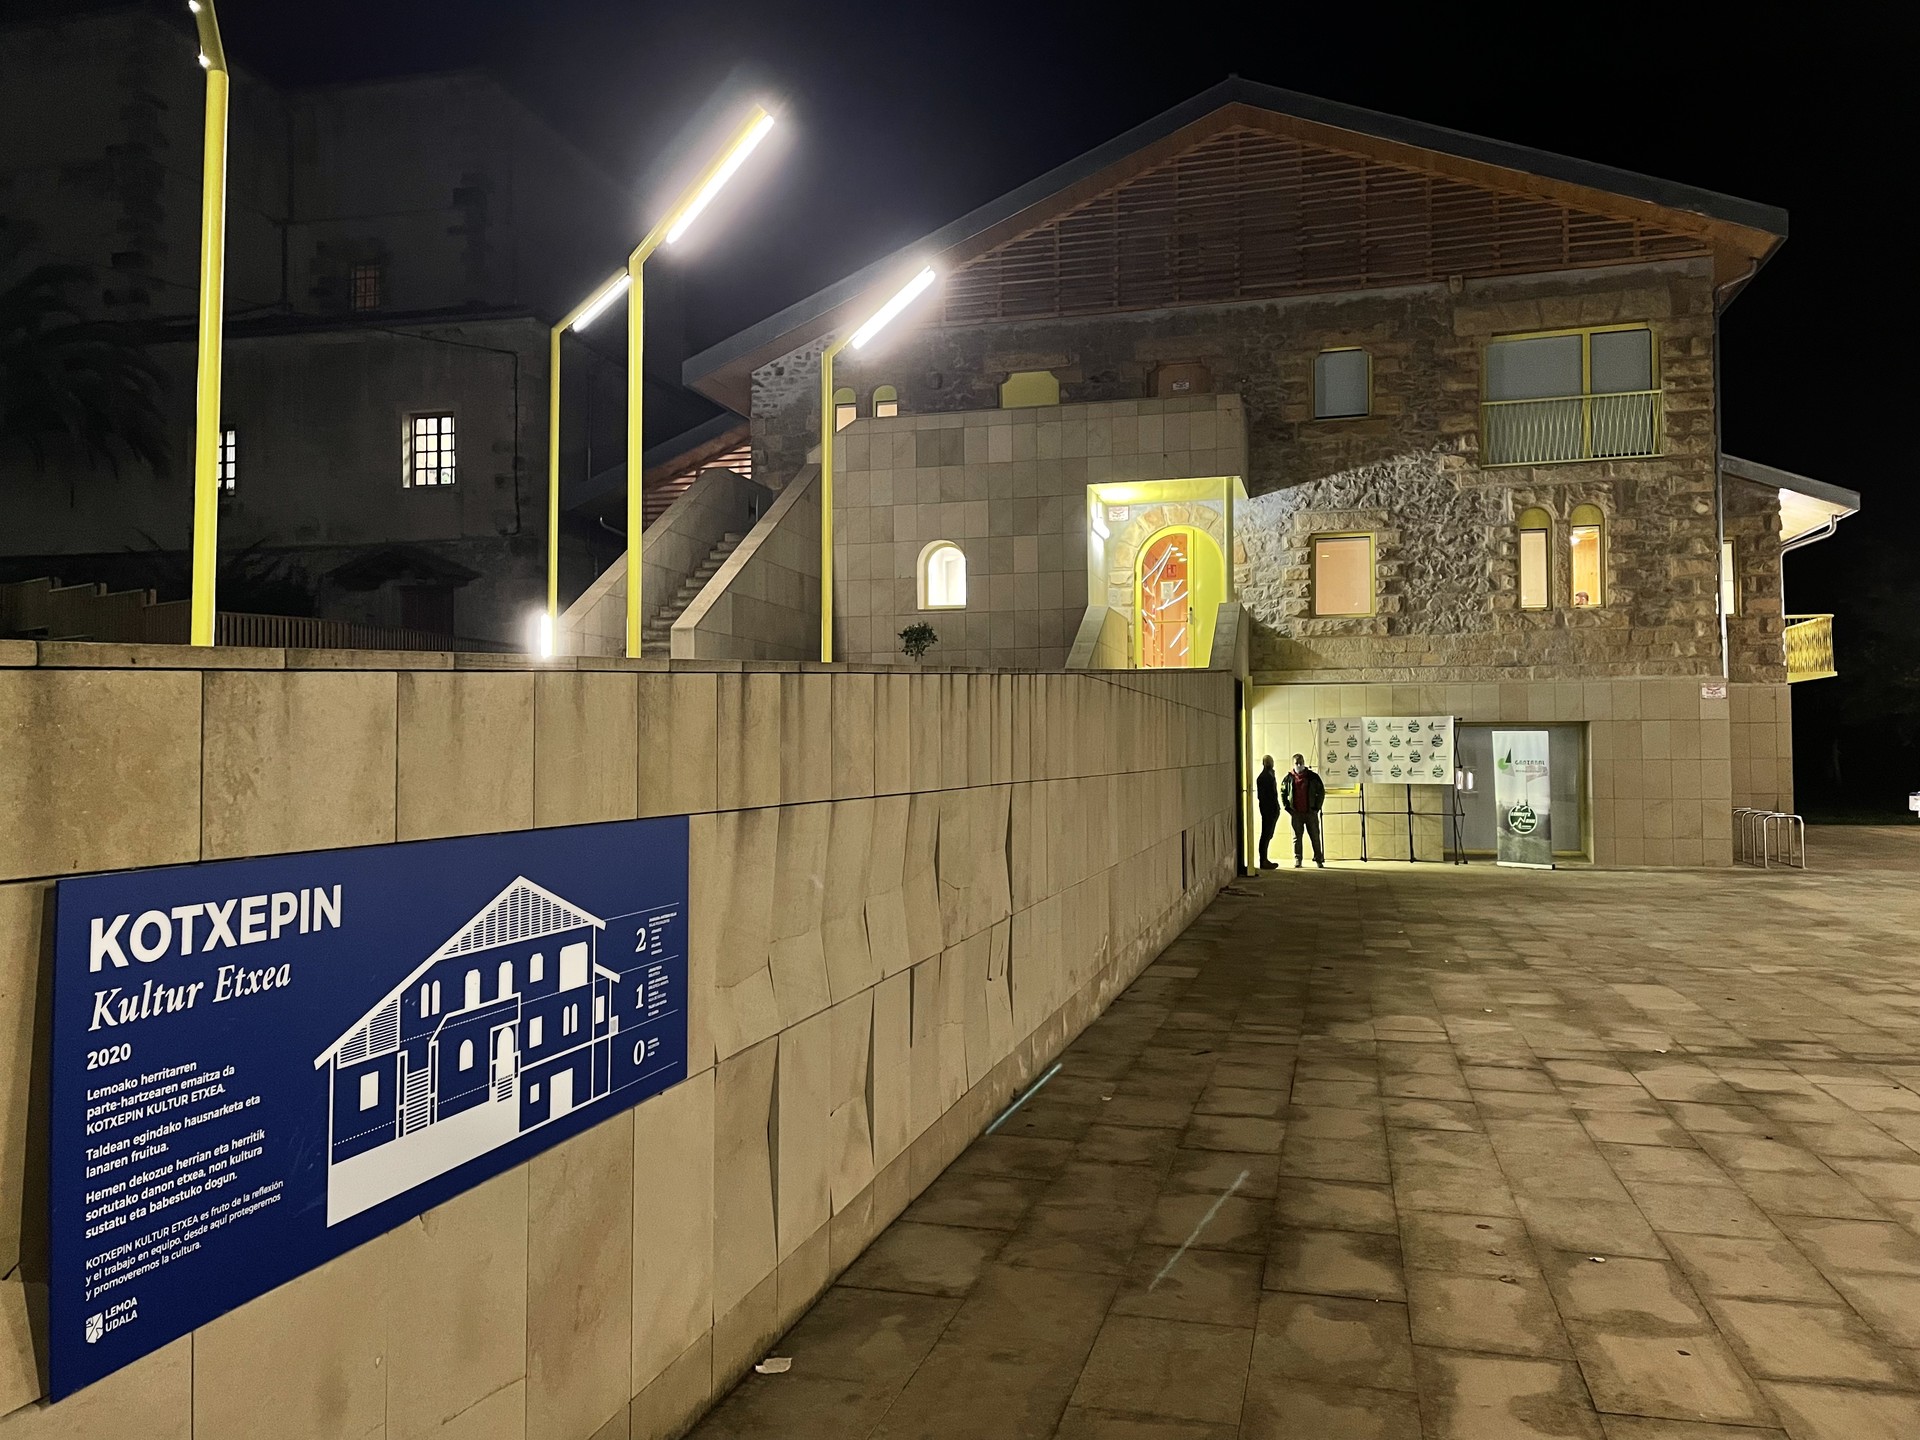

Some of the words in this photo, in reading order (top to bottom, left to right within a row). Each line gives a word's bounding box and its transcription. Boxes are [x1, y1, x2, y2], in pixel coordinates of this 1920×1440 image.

[89, 884, 342, 973] KOTXEPIN
[635, 927, 647, 952] 2
[87, 979, 204, 1032] Kultur
[212, 963, 291, 1003] Etxea
[635, 983, 644, 1009] 1
[86, 1042, 131, 1070] 2020
[633, 1039, 645, 1065] 0
[86, 1083, 178, 1121] parte-hartzearen
[180, 1071, 220, 1090] emaitza
[222, 1065, 235, 1078] da
[86, 1108, 144, 1135] KOTXEPIN
[146, 1094, 188, 1117] KULTUR
[191, 1083, 226, 1103] ETXEA.
[87, 1075, 138, 1101] Lemoako
[140, 1062, 197, 1085] herritarren
[86, 1138, 130, 1161] Taldean
[132, 1120, 181, 1146] egindako
[184, 1101, 244, 1128] hausnarketa
[245, 1094, 261, 1107] eta
[85, 1195, 139, 1222] sortutako
[140, 1181, 174, 1200] danon
[177, 1168, 207, 1187] etxea,
[208, 1159, 227, 1175] non
[229, 1146, 263, 1166] kultura
[86, 1156, 128, 1178] lanaren
[131, 1142, 169, 1163] fruitua.
[86, 1182, 126, 1204] Hemen
[129, 1165, 174, 1189] dekozue
[176, 1151, 212, 1171] herrian
[213, 1143, 229, 1156] eta
[231, 1128, 265, 1150] herritik
[85, 1215, 127, 1239] sustatu
[129, 1207, 147, 1221] eta
[149, 1184, 202, 1213] babestuko
[204, 1171, 238, 1192] dogun.
[85, 1242, 133, 1270] KOTXEPIN
[134, 1227, 169, 1250] KULTUR
[171, 1215, 199, 1234] ETXEA
[200, 1210, 209, 1221] es
[210, 1201, 230, 1217] fruto
[231, 1196, 241, 1208] de
[242, 1193, 250, 1202] la
[251, 1179, 284, 1199] reflexión
[85, 1275, 92, 1287] y
[93, 1269, 102, 1281] el
[104, 1257, 136, 1276] trabajo
[137, 1251, 149, 1262] en
[184, 1223, 208, 1241] desde
[209, 1214, 228, 1231] aquí
[228, 1193, 281, 1224] protegeremos
[85, 1290, 92, 1301] y
[93, 1258, 160, 1297] promoveremos
[161, 1254, 170, 1265] la
[171, 1240, 202, 1260] cultura.
[105, 1296, 138, 1320] LEMOA
[105, 1309, 138, 1332] UDALA
